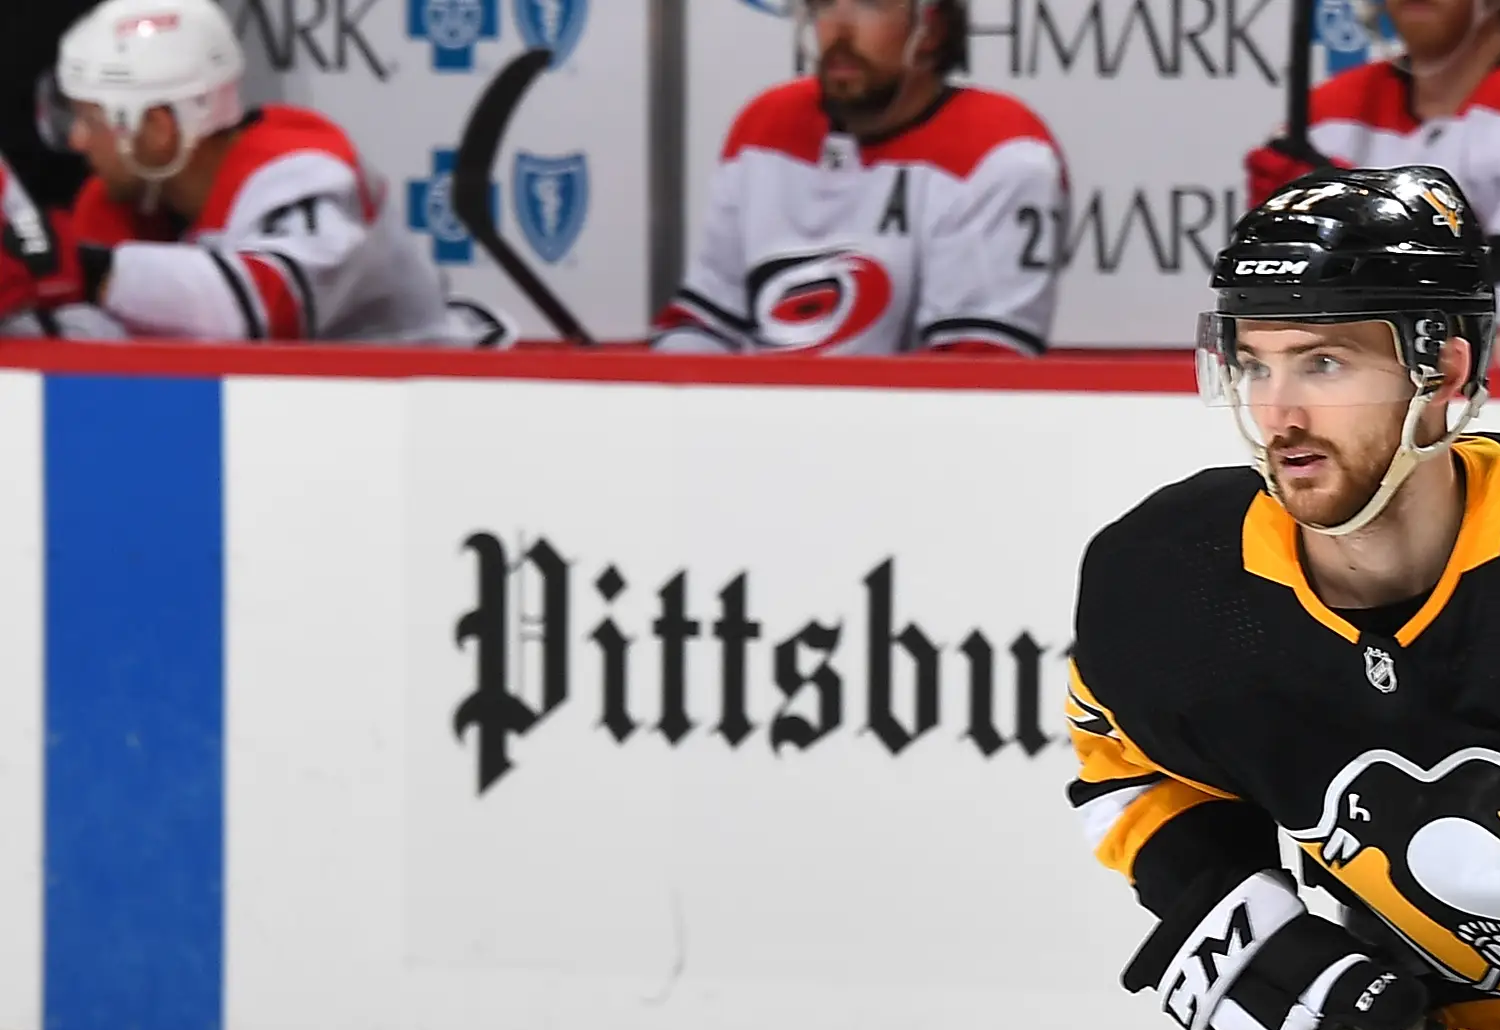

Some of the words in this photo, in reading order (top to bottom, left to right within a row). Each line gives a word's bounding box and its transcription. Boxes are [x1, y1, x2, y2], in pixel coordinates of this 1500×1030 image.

[877, 167, 907, 233] A
[1235, 260, 1310, 275] CCM
[452, 531, 1075, 797] Pittsbu
